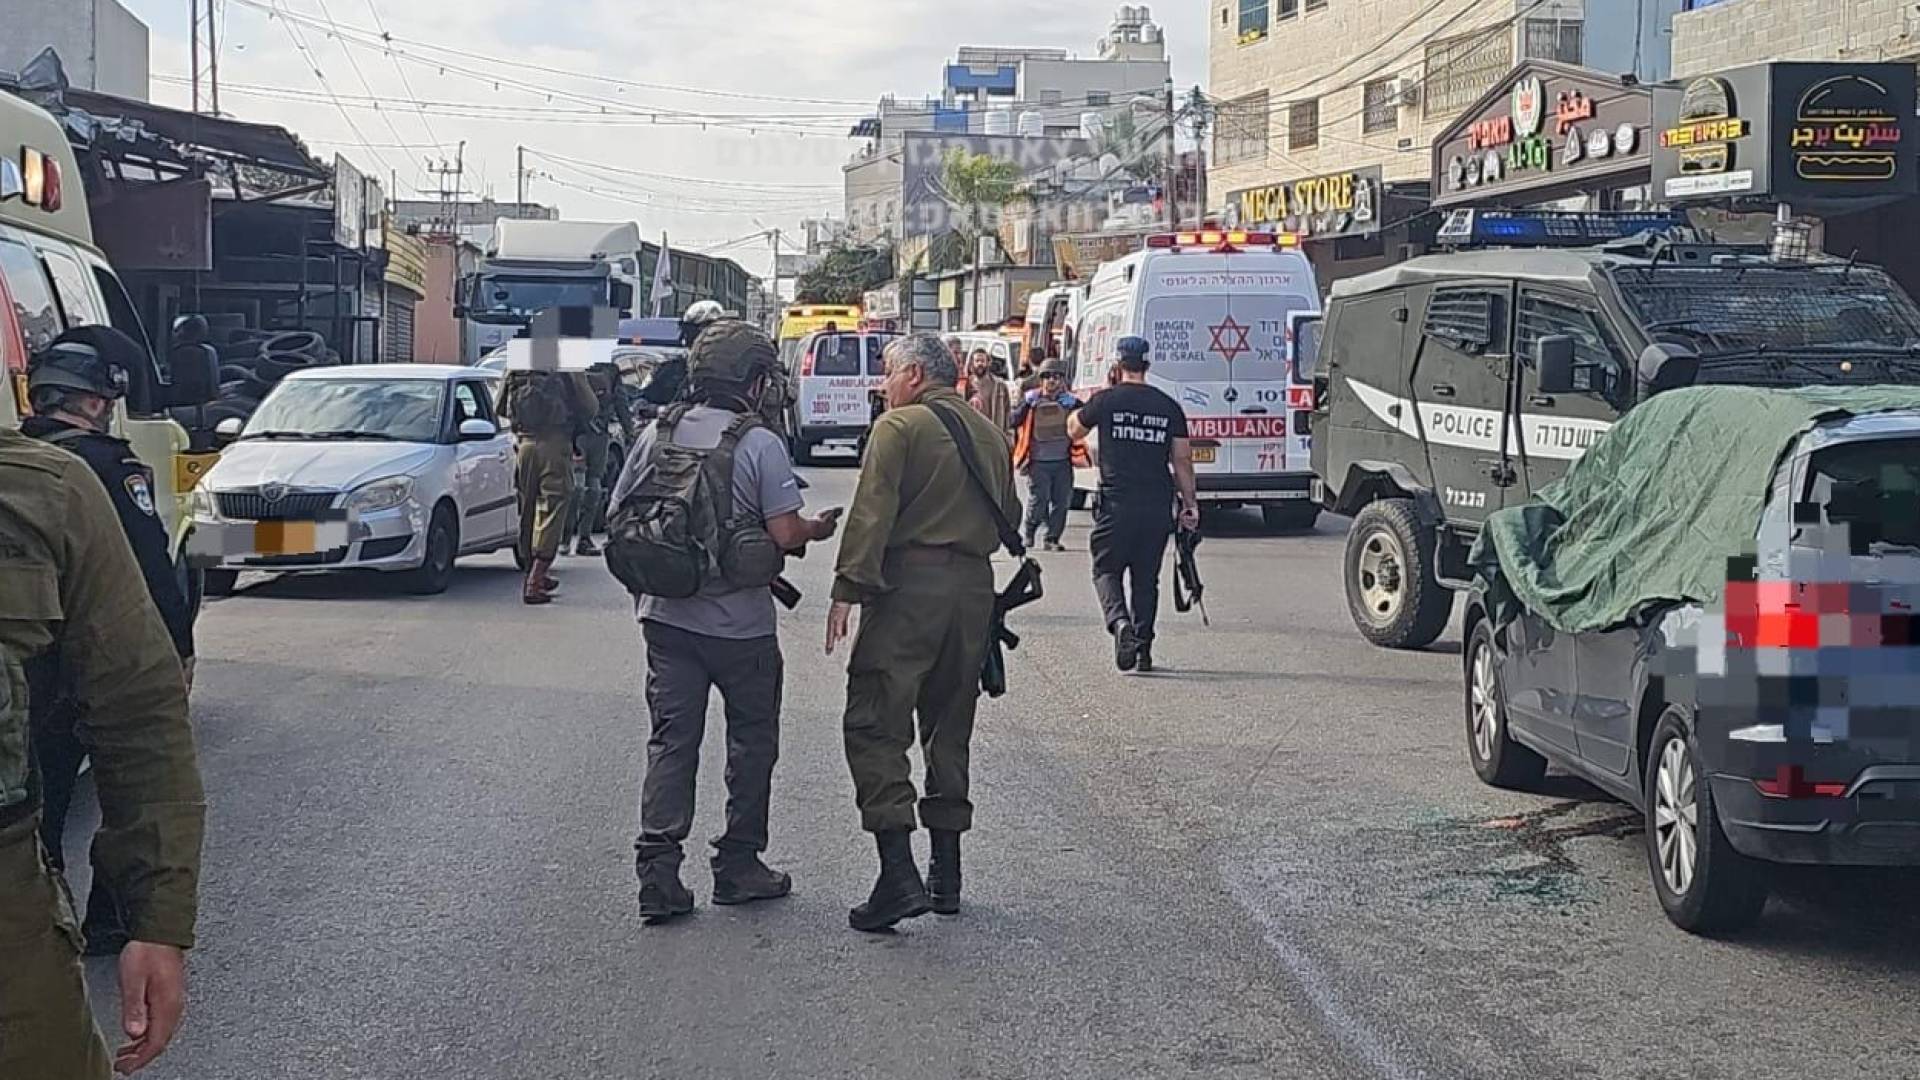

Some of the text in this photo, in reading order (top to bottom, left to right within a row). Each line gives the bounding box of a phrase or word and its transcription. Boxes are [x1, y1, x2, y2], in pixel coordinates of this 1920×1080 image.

[1240, 172, 1353, 224] MEGA STORE
[1161, 275, 1290, 287] ארגון ההצלה הלאומי
[1154, 320, 1194, 331] MAGEN
[1154, 331, 1189, 340] DAVID
[1154, 341, 1190, 350] ADOM
[1154, 350, 1207, 361] IN ISRAEL
[829, 378, 884, 388] AMBULAN
[1187, 419, 1286, 437] MBULANC
[1432, 412, 1494, 438] POLICE
[1112, 426, 1166, 443] אבטחה
[1445, 486, 1486, 508] הגבול
